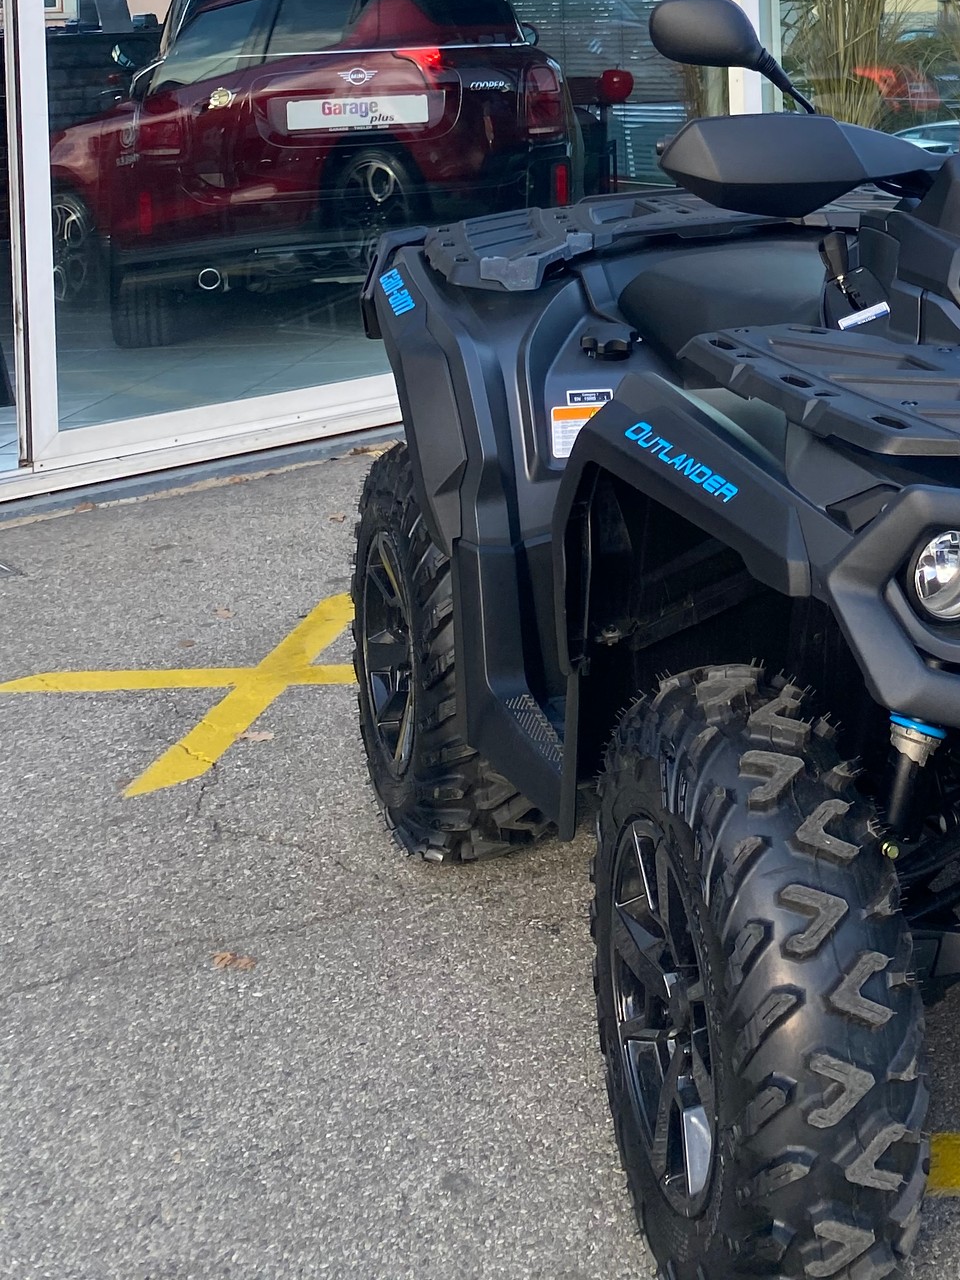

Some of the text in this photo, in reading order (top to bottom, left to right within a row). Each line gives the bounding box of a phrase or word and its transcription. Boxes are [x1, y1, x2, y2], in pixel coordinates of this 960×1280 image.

[321, 99, 379, 118] Garage
[370, 112, 395, 124] plus
[624, 421, 739, 503] OUTLANDER
